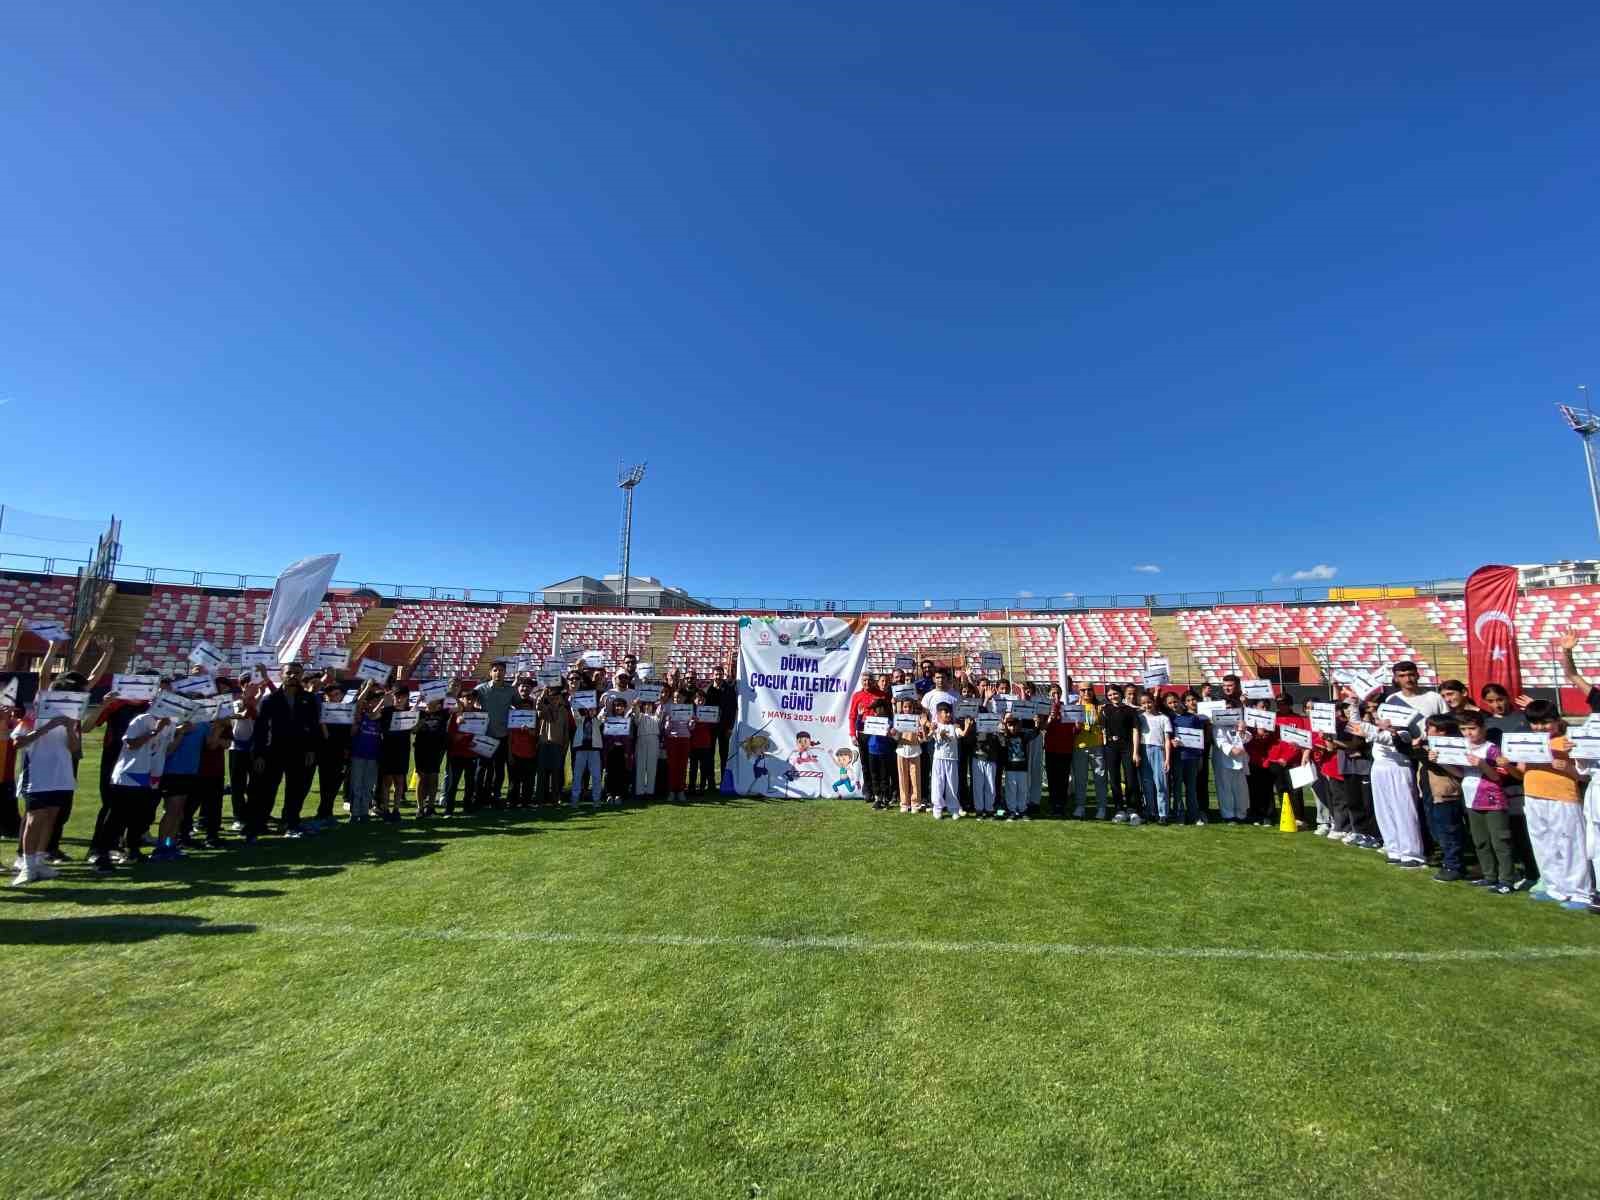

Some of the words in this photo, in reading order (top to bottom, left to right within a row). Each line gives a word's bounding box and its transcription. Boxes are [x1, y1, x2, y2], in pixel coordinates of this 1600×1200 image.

[781, 654, 818, 673] DÜNYA
[750, 673, 788, 692] ÇOCUK
[781, 692, 813, 711] GÜNÜ
[767, 711, 792, 720] MAYIS
[820, 715, 836, 723] VAN
